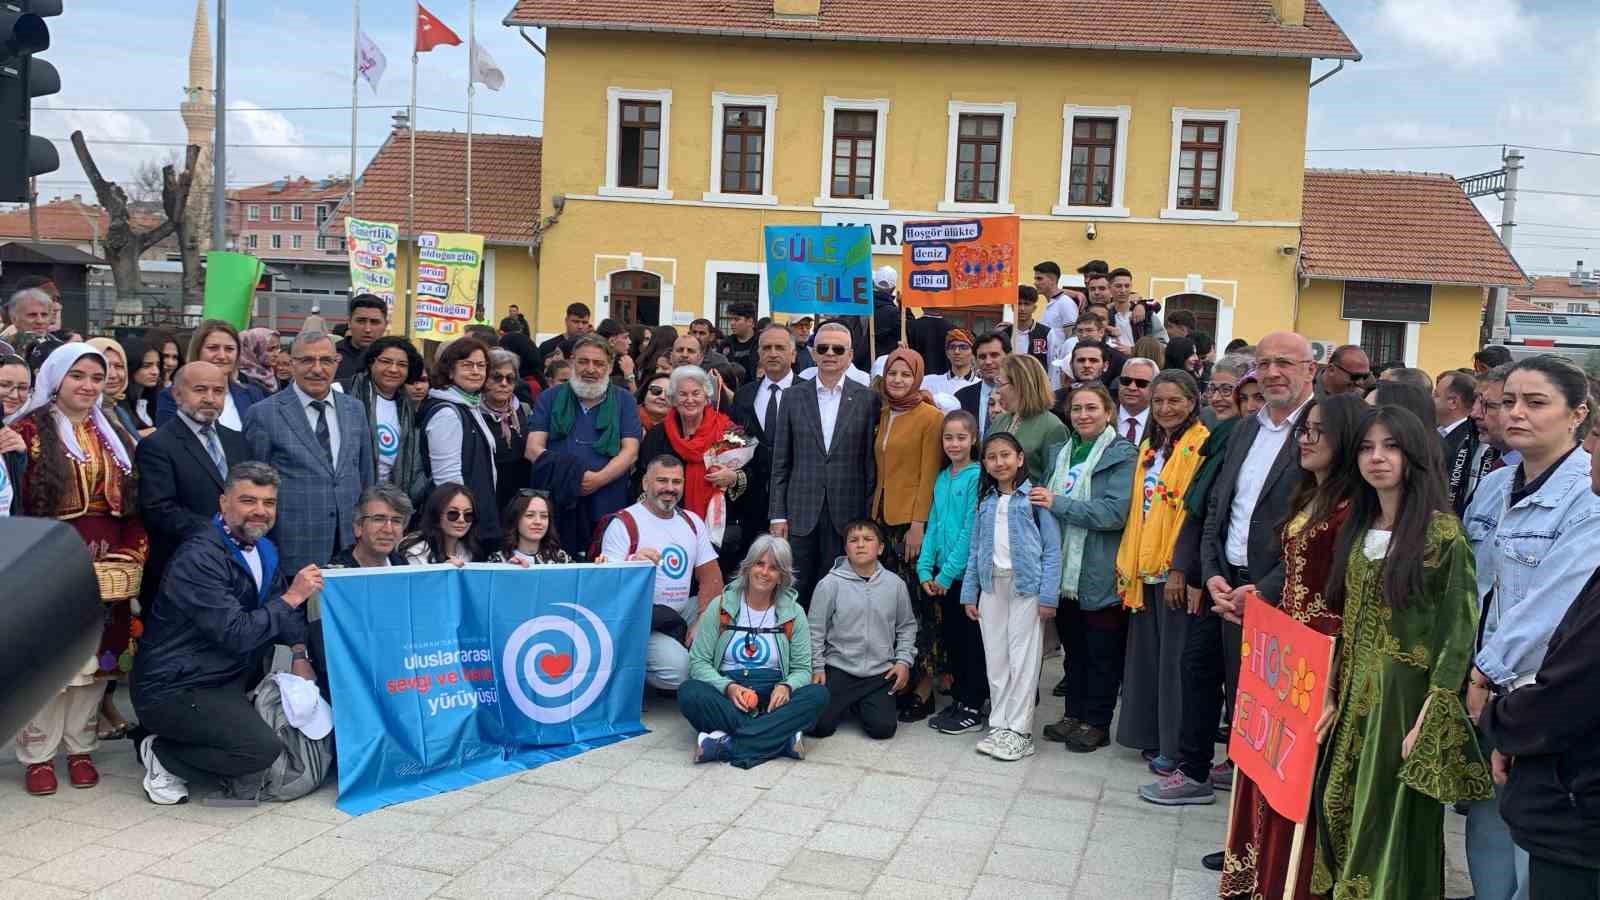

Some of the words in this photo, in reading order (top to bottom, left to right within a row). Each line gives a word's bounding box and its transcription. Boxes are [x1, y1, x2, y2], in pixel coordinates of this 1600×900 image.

[772, 232, 838, 265] GÜLE
[915, 248, 943, 259] deniz
[795, 272, 869, 305] GÜLE
[915, 275, 934, 288] gibi
[936, 274, 946, 285] ol
[1450, 447, 1468, 487] MONCLER
[404, 648, 492, 670] uluslararası
[386, 675, 432, 694] sevgi
[436, 671, 457, 685] ve
[428, 687, 497, 716] yürüyüşü
